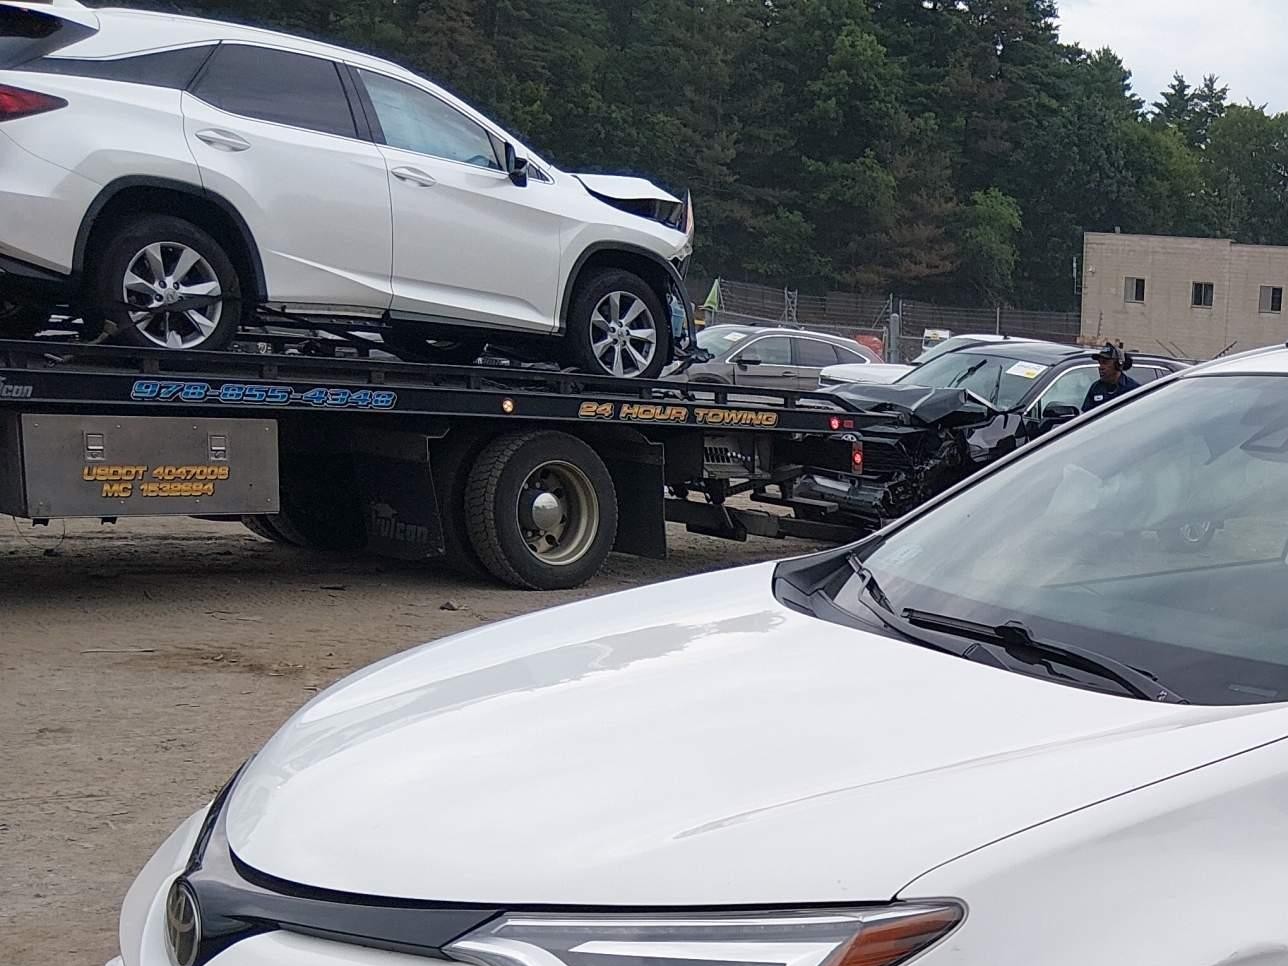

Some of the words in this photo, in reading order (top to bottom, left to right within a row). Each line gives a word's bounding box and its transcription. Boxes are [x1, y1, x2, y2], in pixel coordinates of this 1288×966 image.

[131, 380, 397, 409] 978-855-4348
[579, 401, 614, 419] 24
[620, 403, 689, 423] HOUR
[695, 407, 778, 428] TOWING
[83, 465, 148, 481] USDOT
[102, 483, 132, 498] MC
